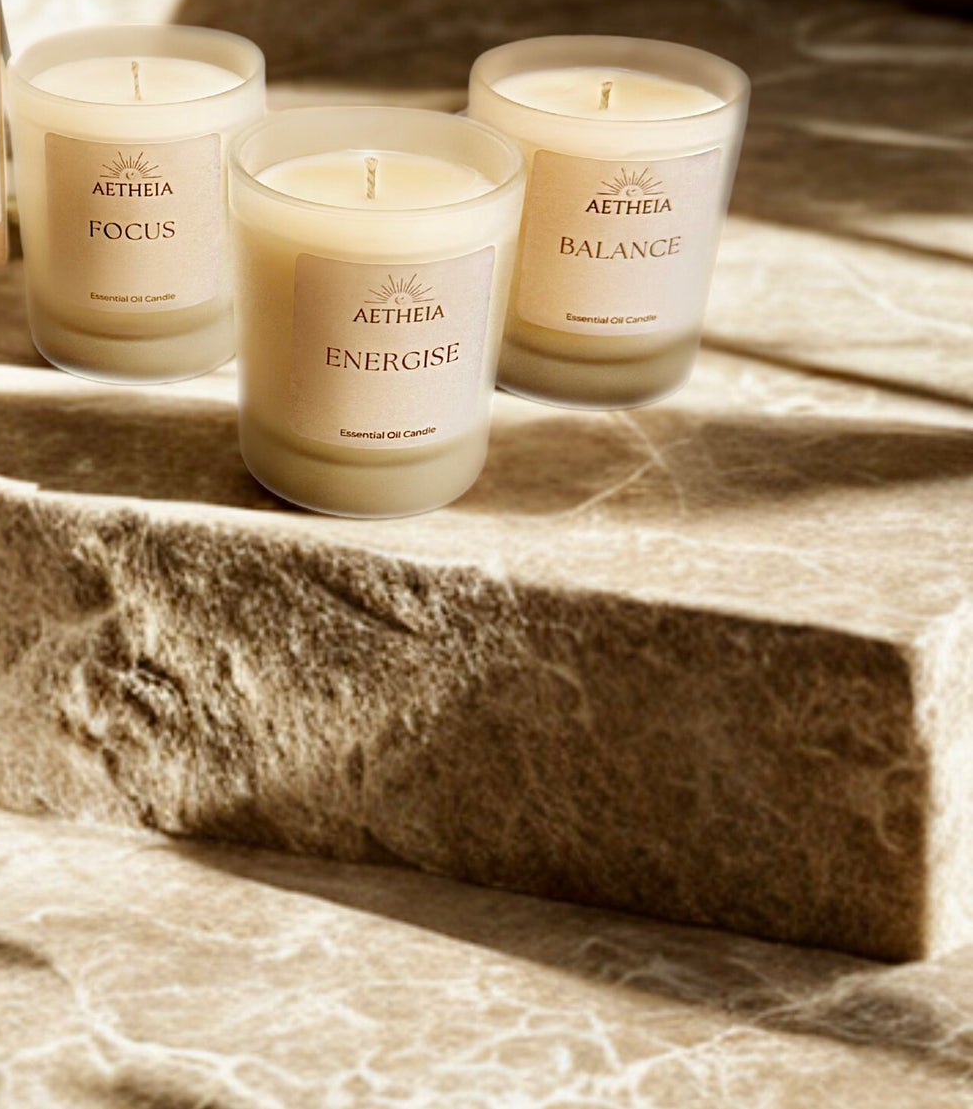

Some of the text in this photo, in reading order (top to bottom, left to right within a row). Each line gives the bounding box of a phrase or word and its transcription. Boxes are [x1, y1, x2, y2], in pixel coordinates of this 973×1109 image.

[92, 181, 174, 197] AETHEIA
[585, 198, 672, 215] AETHEIA
[89, 220, 176, 241] FOCUS
[559, 235, 682, 260] BALANCE
[90, 291, 176, 303] Essential Oil Candle
[352, 304, 446, 324] AETHEIA
[566, 312, 657, 325] Essential Oil Candle
[325, 342, 460, 372] ENERGISE
[340, 426, 437, 440] Essential Oil Candle
